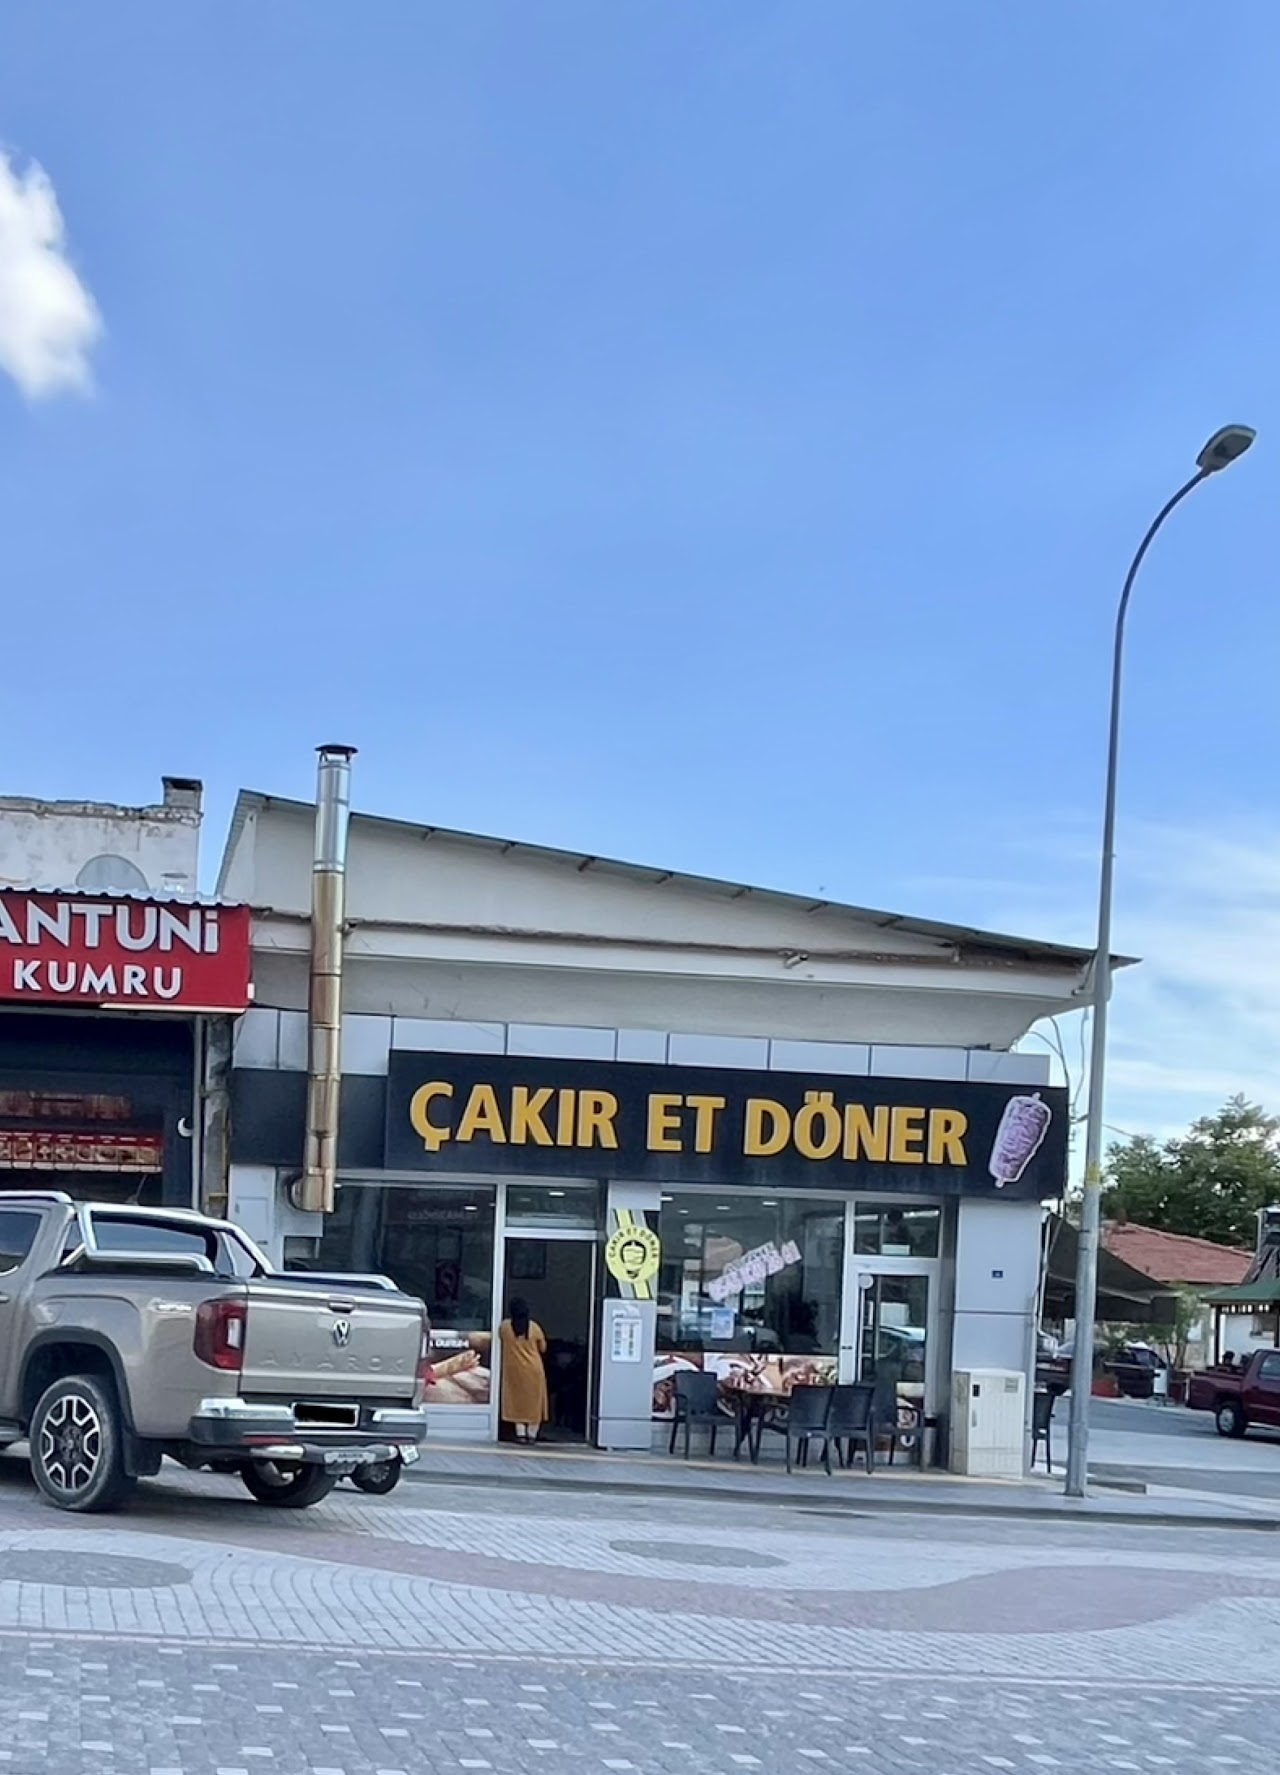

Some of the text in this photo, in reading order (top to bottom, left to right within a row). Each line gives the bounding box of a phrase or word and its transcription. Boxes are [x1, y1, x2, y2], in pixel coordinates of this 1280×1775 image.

[13, 958, 182, 999] KUMRU
[409, 1081, 968, 1166] ÇAKIR ET DÖNER
